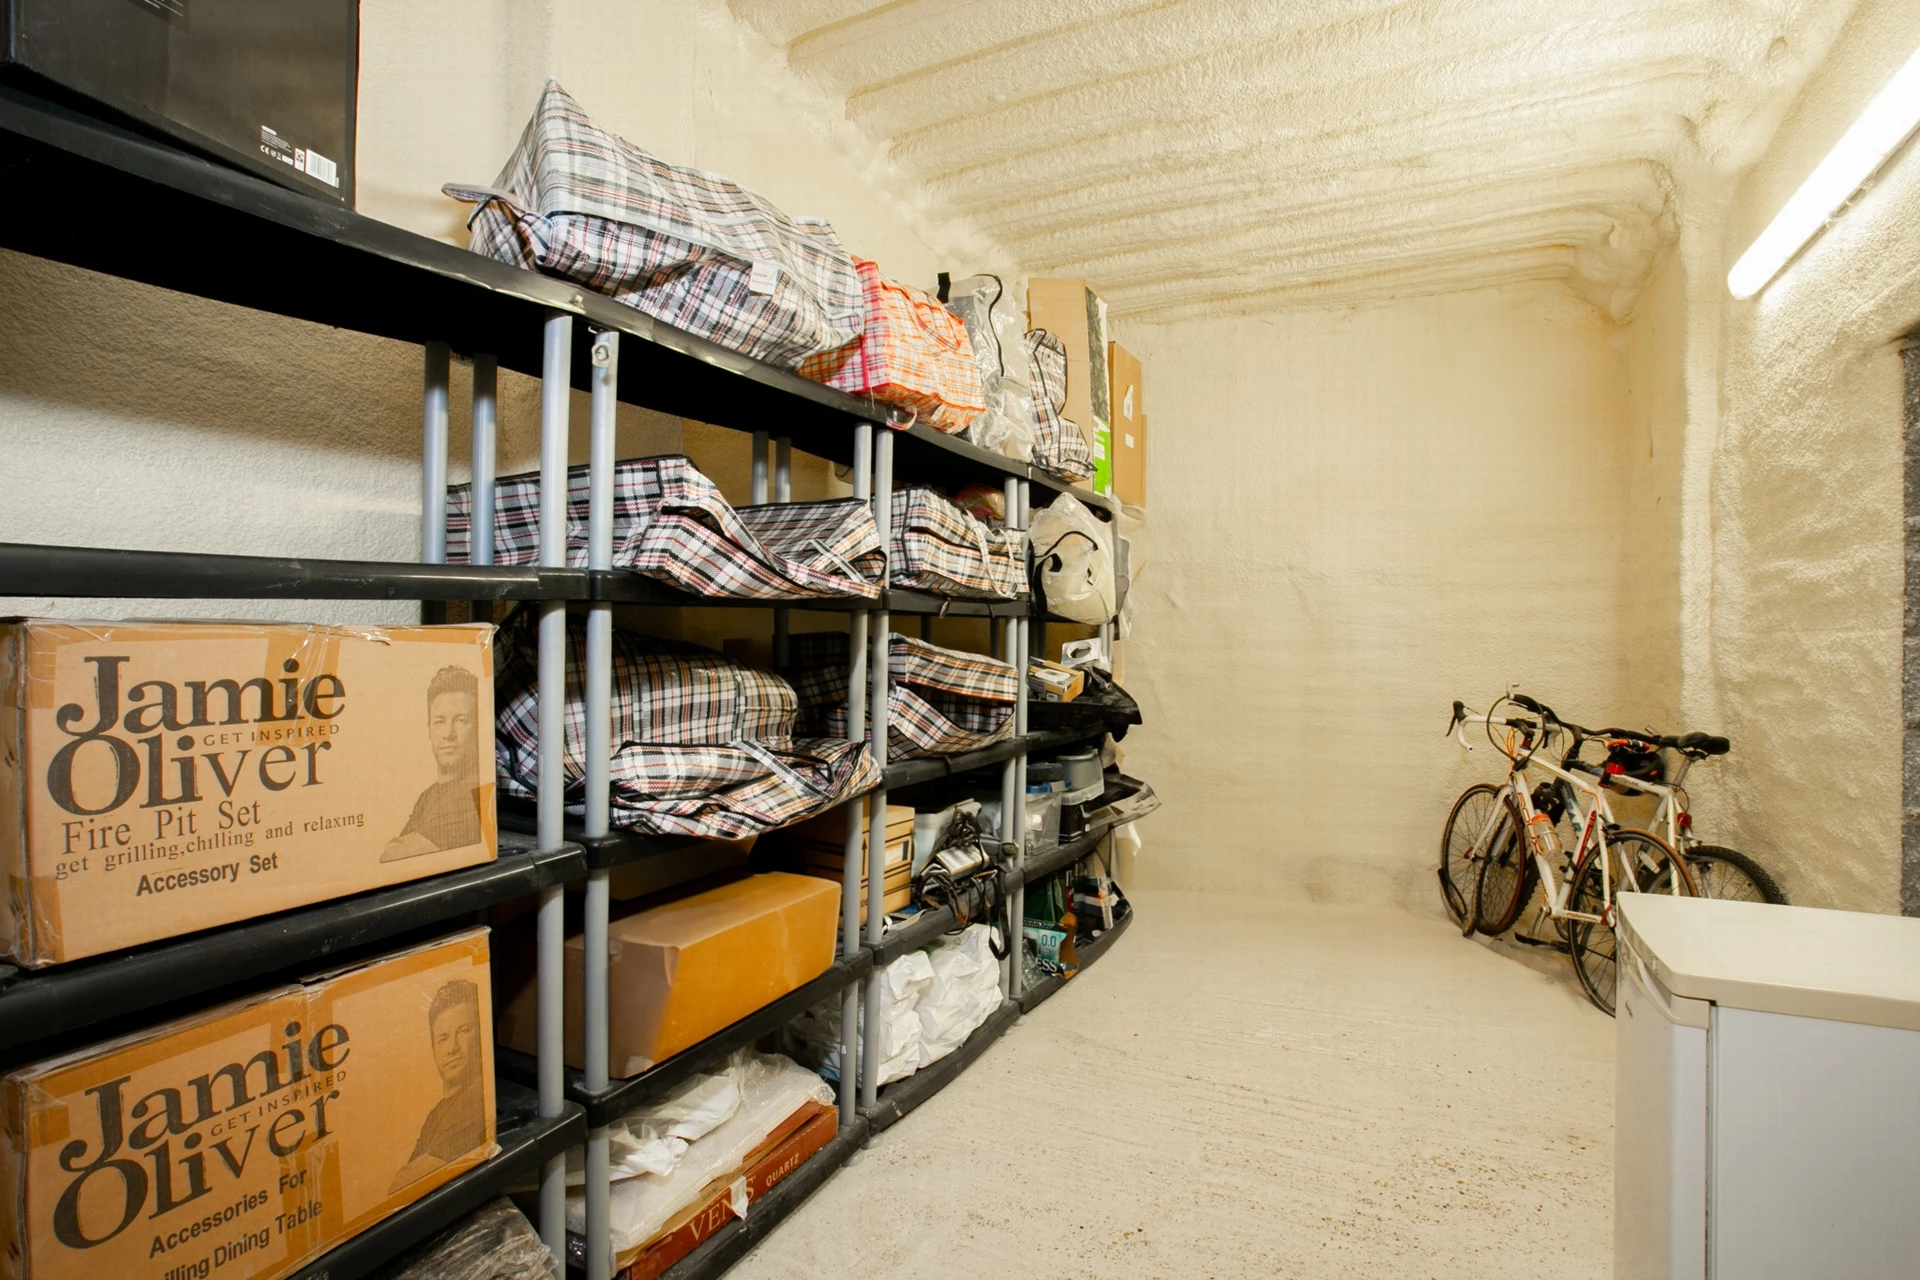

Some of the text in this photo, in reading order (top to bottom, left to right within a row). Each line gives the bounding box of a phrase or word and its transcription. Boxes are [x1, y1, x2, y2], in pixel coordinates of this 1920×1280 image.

[56, 656, 346, 736] Jamie
[203, 723, 341, 747] GET INSPIRED
[47, 730, 332, 816] Oliver
[55, 854, 89, 880] get
[265, 821, 293, 841] and
[304, 813, 365, 834] relaxing
[62, 800, 262, 855] Fire Pit Set
[136, 852, 279, 896] Accessory Set
[1041, 934, 1057, 947] 0.0
[59, 1021, 350, 1172] Jamie
[211, 1070, 348, 1137] GET INSPIRED
[53, 1088, 340, 1249] Oliver
[765, 1153, 800, 1187] QUARTZ
[150, 1169, 307, 1259] Accessories For
[214, 1227, 270, 1269] Dining
[275, 1200, 322, 1234] Table
[689, 1177, 755, 1241] VENS
